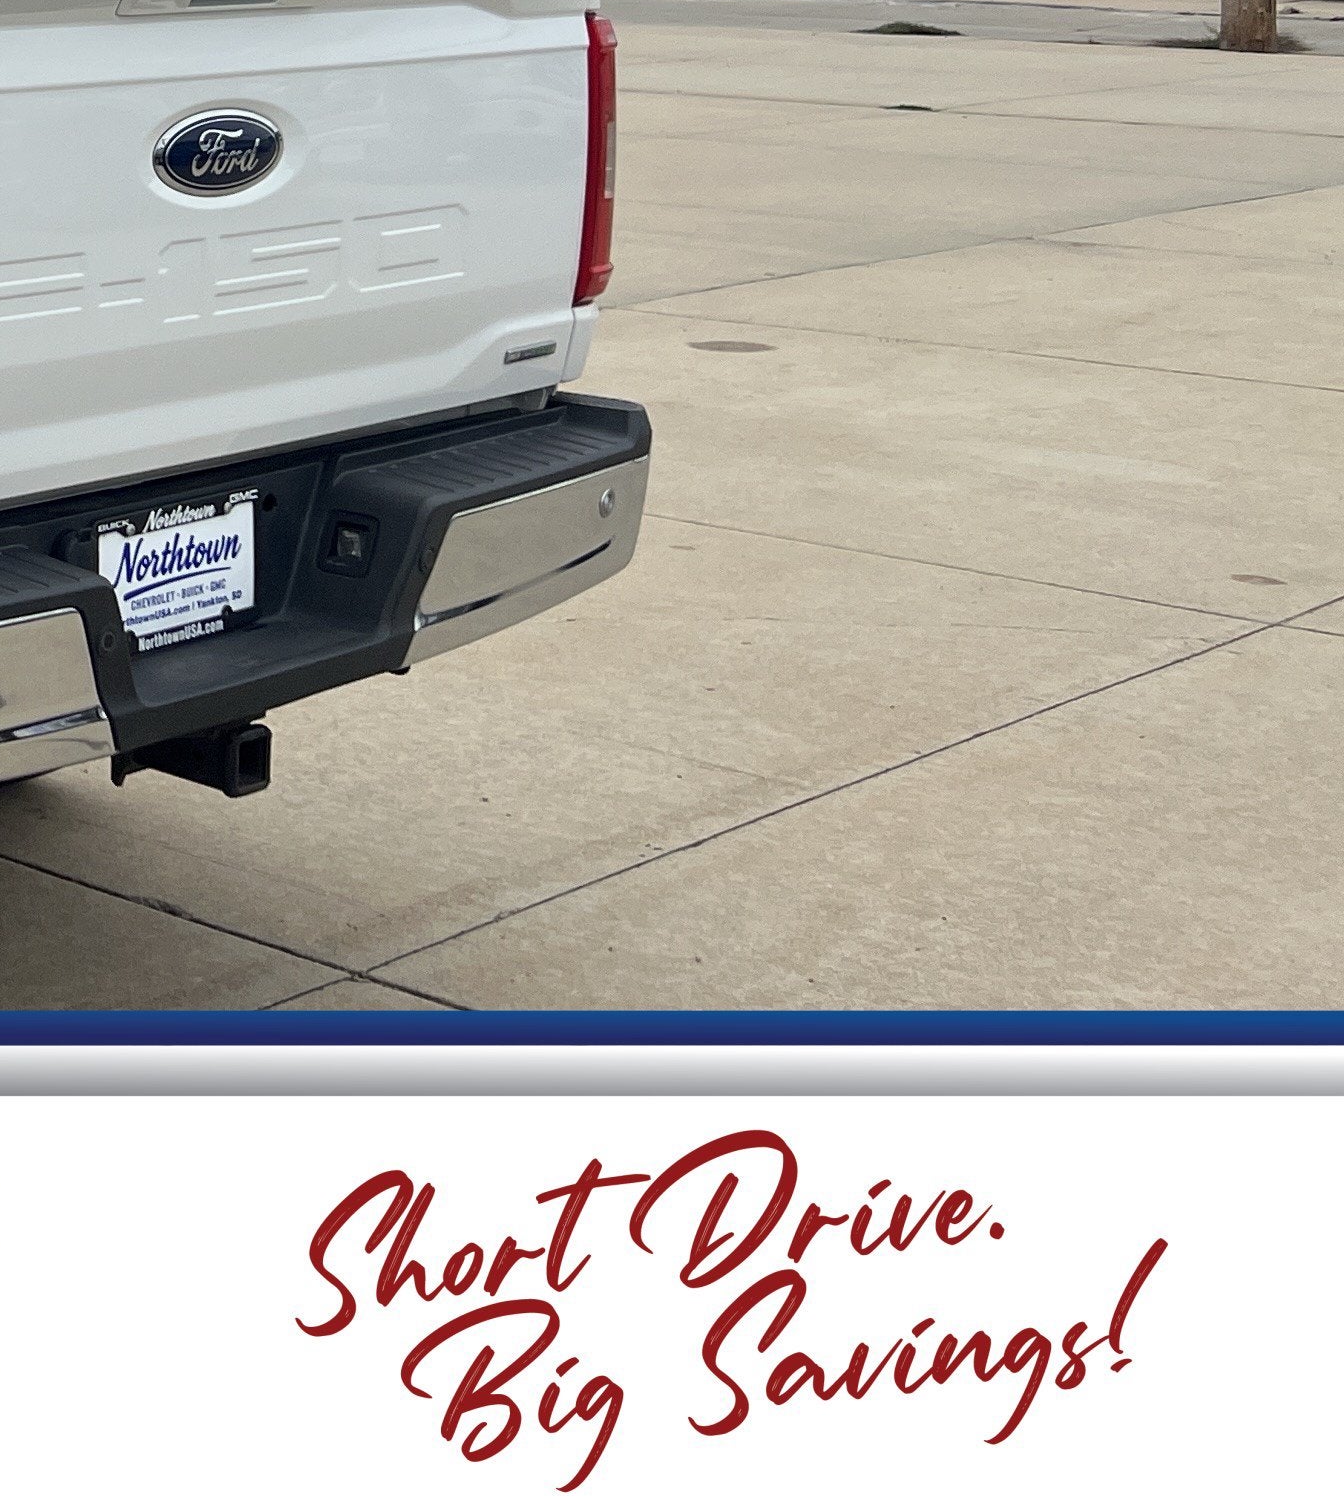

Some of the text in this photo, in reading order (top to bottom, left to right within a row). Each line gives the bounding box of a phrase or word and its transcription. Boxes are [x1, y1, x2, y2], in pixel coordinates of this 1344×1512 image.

[191, 128, 261, 177] Ford
[229, 489, 259, 504] GMC
[142, 504, 216, 533] Northtown
[113, 533, 242, 588] Northtown
[131, 578, 227, 611] CHEVROLET BUICK GMC
[138, 619, 224, 652] NorthtownUSA.com
